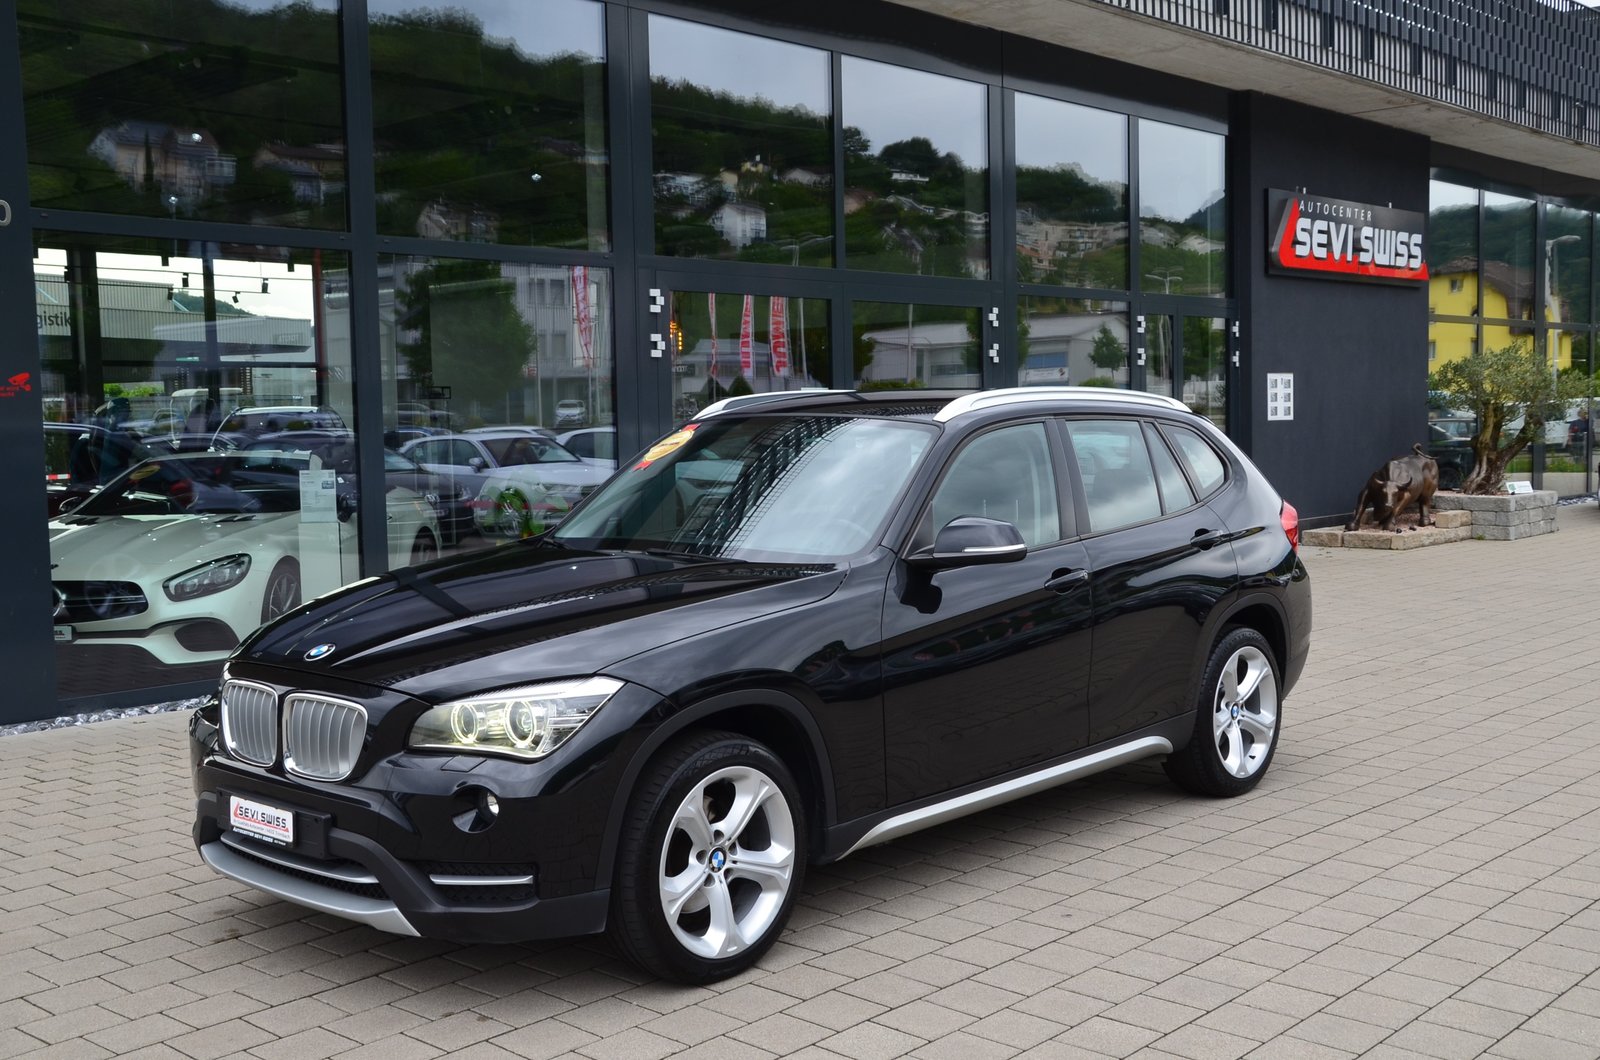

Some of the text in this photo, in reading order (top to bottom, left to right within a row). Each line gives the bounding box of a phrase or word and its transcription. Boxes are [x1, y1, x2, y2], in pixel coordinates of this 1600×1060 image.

[1299, 200, 1373, 221] AUTOCENTER
[1295, 217, 1423, 269] SEVI SWISS
[239, 806, 259, 820] SEVI
[261, 813, 286, 828] SWISS
